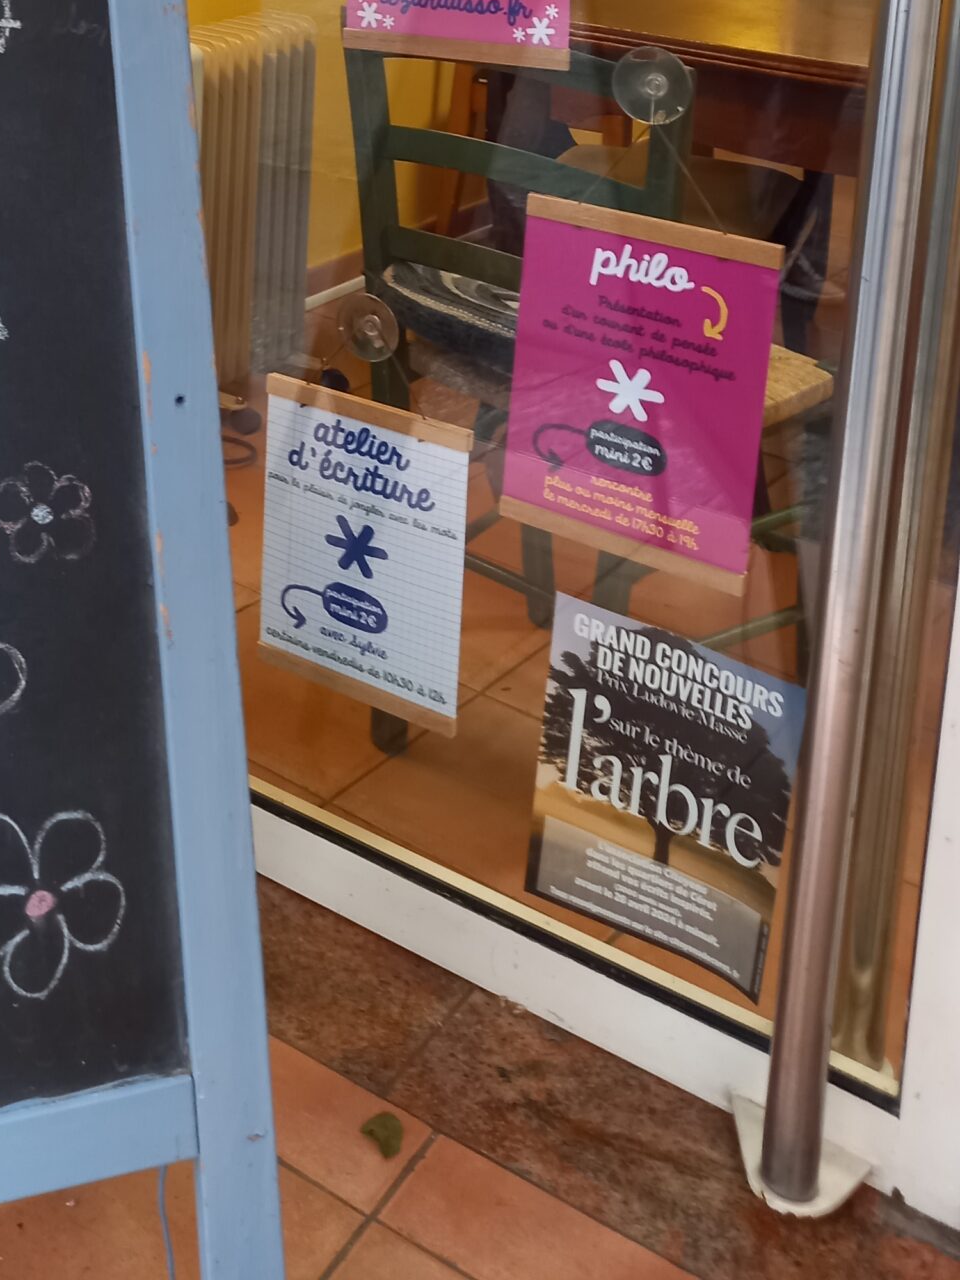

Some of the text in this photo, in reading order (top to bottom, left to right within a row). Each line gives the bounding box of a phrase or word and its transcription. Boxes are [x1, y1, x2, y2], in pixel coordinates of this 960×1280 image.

[589, 244, 695, 293] philo
[313, 418, 410, 471] atelier
[590, 428, 661, 457] participation
[594, 444, 654, 471] mini 2€
[288, 441, 436, 512] d'écriture
[544, 475, 573, 492] plus
[592, 492, 634, 512] moins
[591, 476, 654, 503] rencontre
[615, 514, 630, 527] de
[632, 519, 664, 538] 17h30
[573, 613, 784, 718] GRAND CONCOURS
[597, 669, 628, 694] Prix
[596, 645, 753, 731] DE NOUVELLES
[609, 718, 752, 789] sur le thème de
